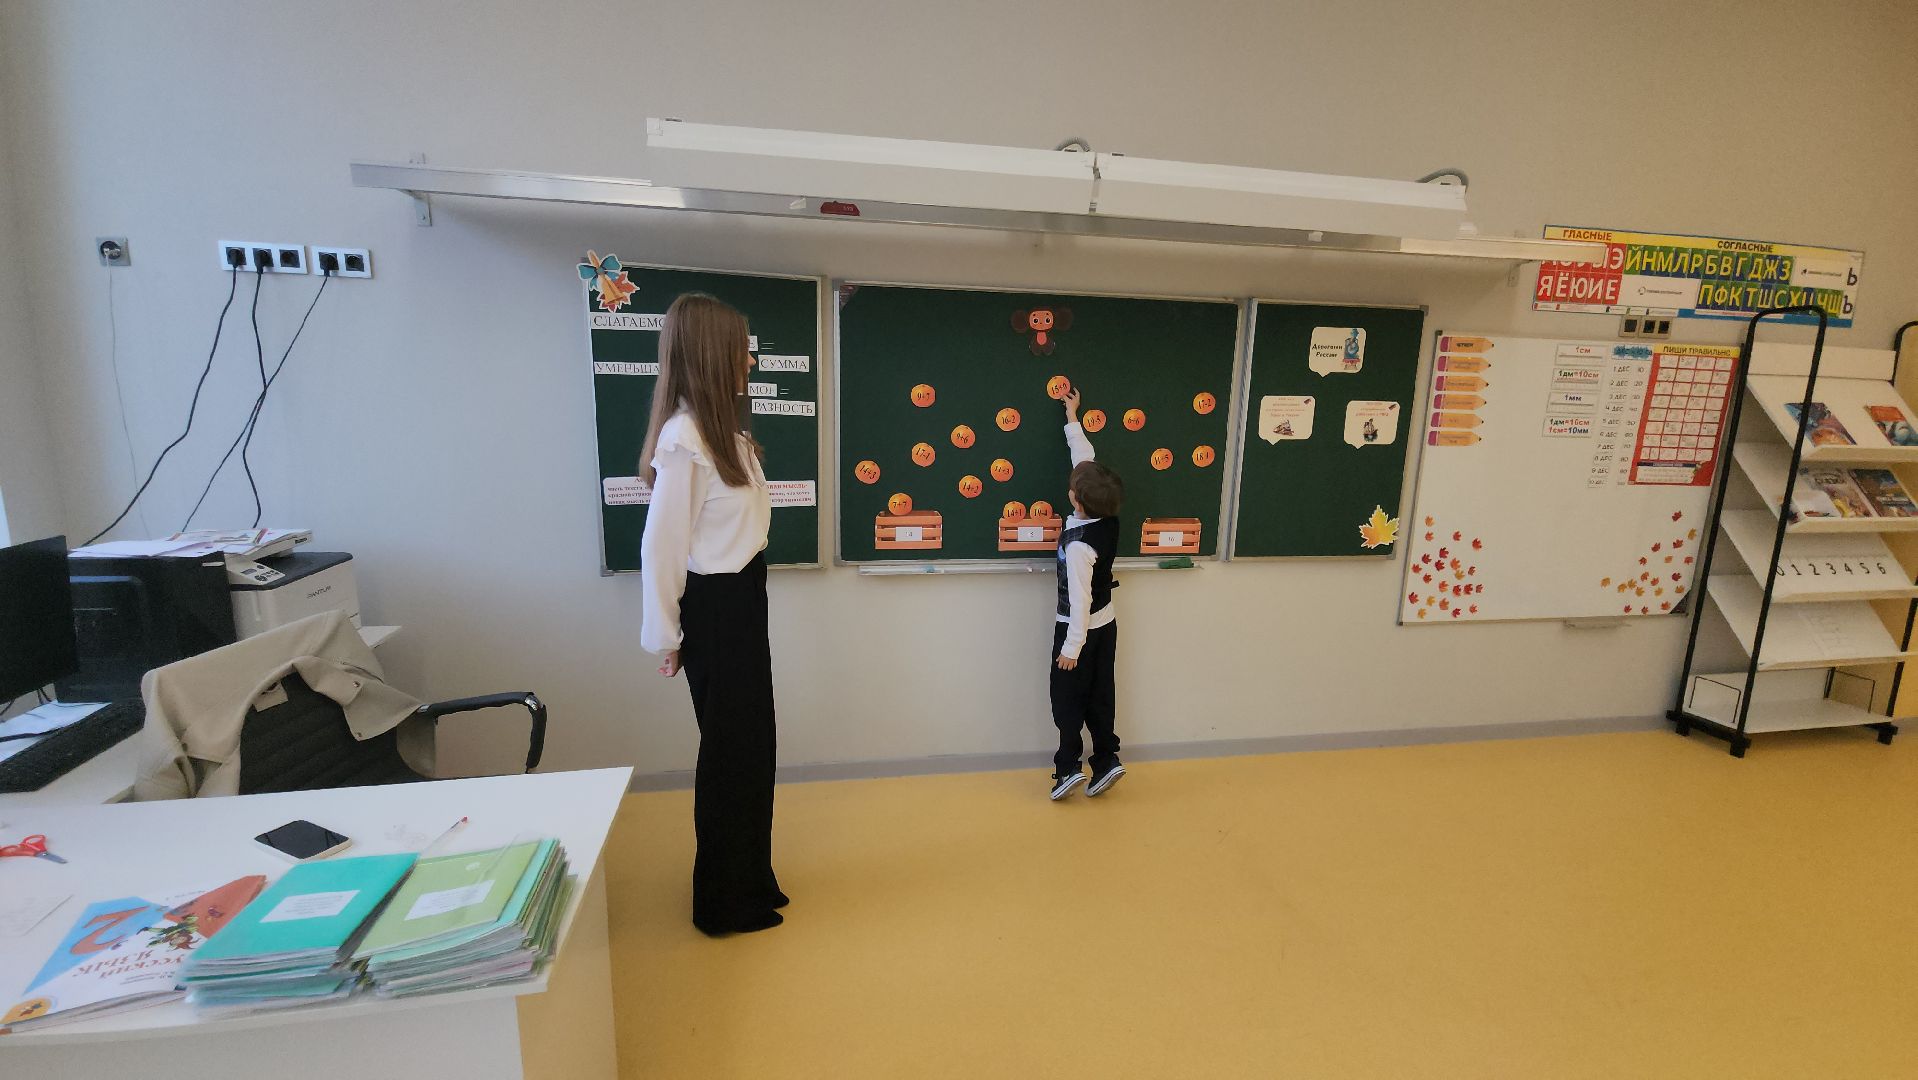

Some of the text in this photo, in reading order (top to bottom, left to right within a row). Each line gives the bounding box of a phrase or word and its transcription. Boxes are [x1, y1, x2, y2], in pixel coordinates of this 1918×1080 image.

[1562, 229, 1612, 241] ГЛАСНЫЕ
[1717, 241, 1774, 253] СОГЛАСНЫЕ
[760, 359, 807, 370] СУММА
[754, 402, 813, 413] РАЗНОСТЬ
[1790, 563, 1802, 576] 1
[1808, 563, 1820, 576] 2
[1826, 562, 1837, 575] 3
[1844, 562, 1854, 575] 4
[1859, 562, 1870, 574] 5
[1876, 562, 1887, 574] 6
[69, 906, 150, 955] 2
